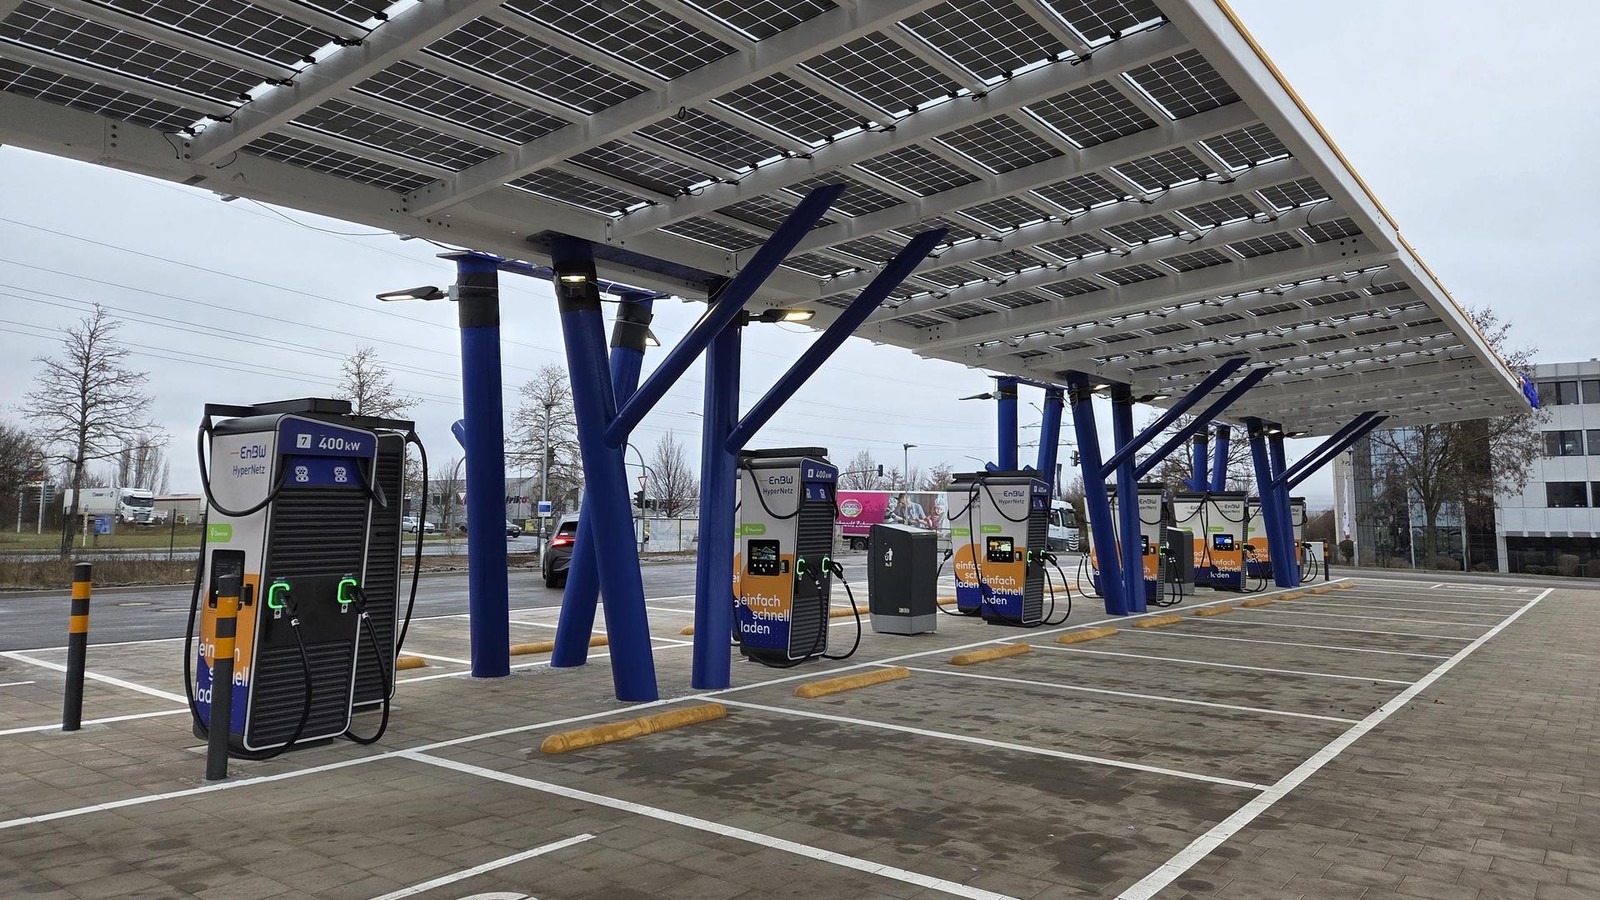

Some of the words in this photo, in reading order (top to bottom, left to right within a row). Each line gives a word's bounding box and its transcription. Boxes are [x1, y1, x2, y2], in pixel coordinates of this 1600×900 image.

[240, 444, 267, 459] EnBW
[318, 437, 344, 451] 400
[344, 441, 361, 452] kW
[232, 463, 266, 478] HyperNetz
[768, 475, 794, 485] EnBW
[762, 487, 793, 497] HyperNetz
[981, 575, 1016, 586] einfach
[991, 586, 1023, 596] schnell
[741, 593, 781, 607] einfach
[752, 608, 790, 622] schnell
[740, 620, 770, 634] laden
[195, 682, 213, 704] lad
